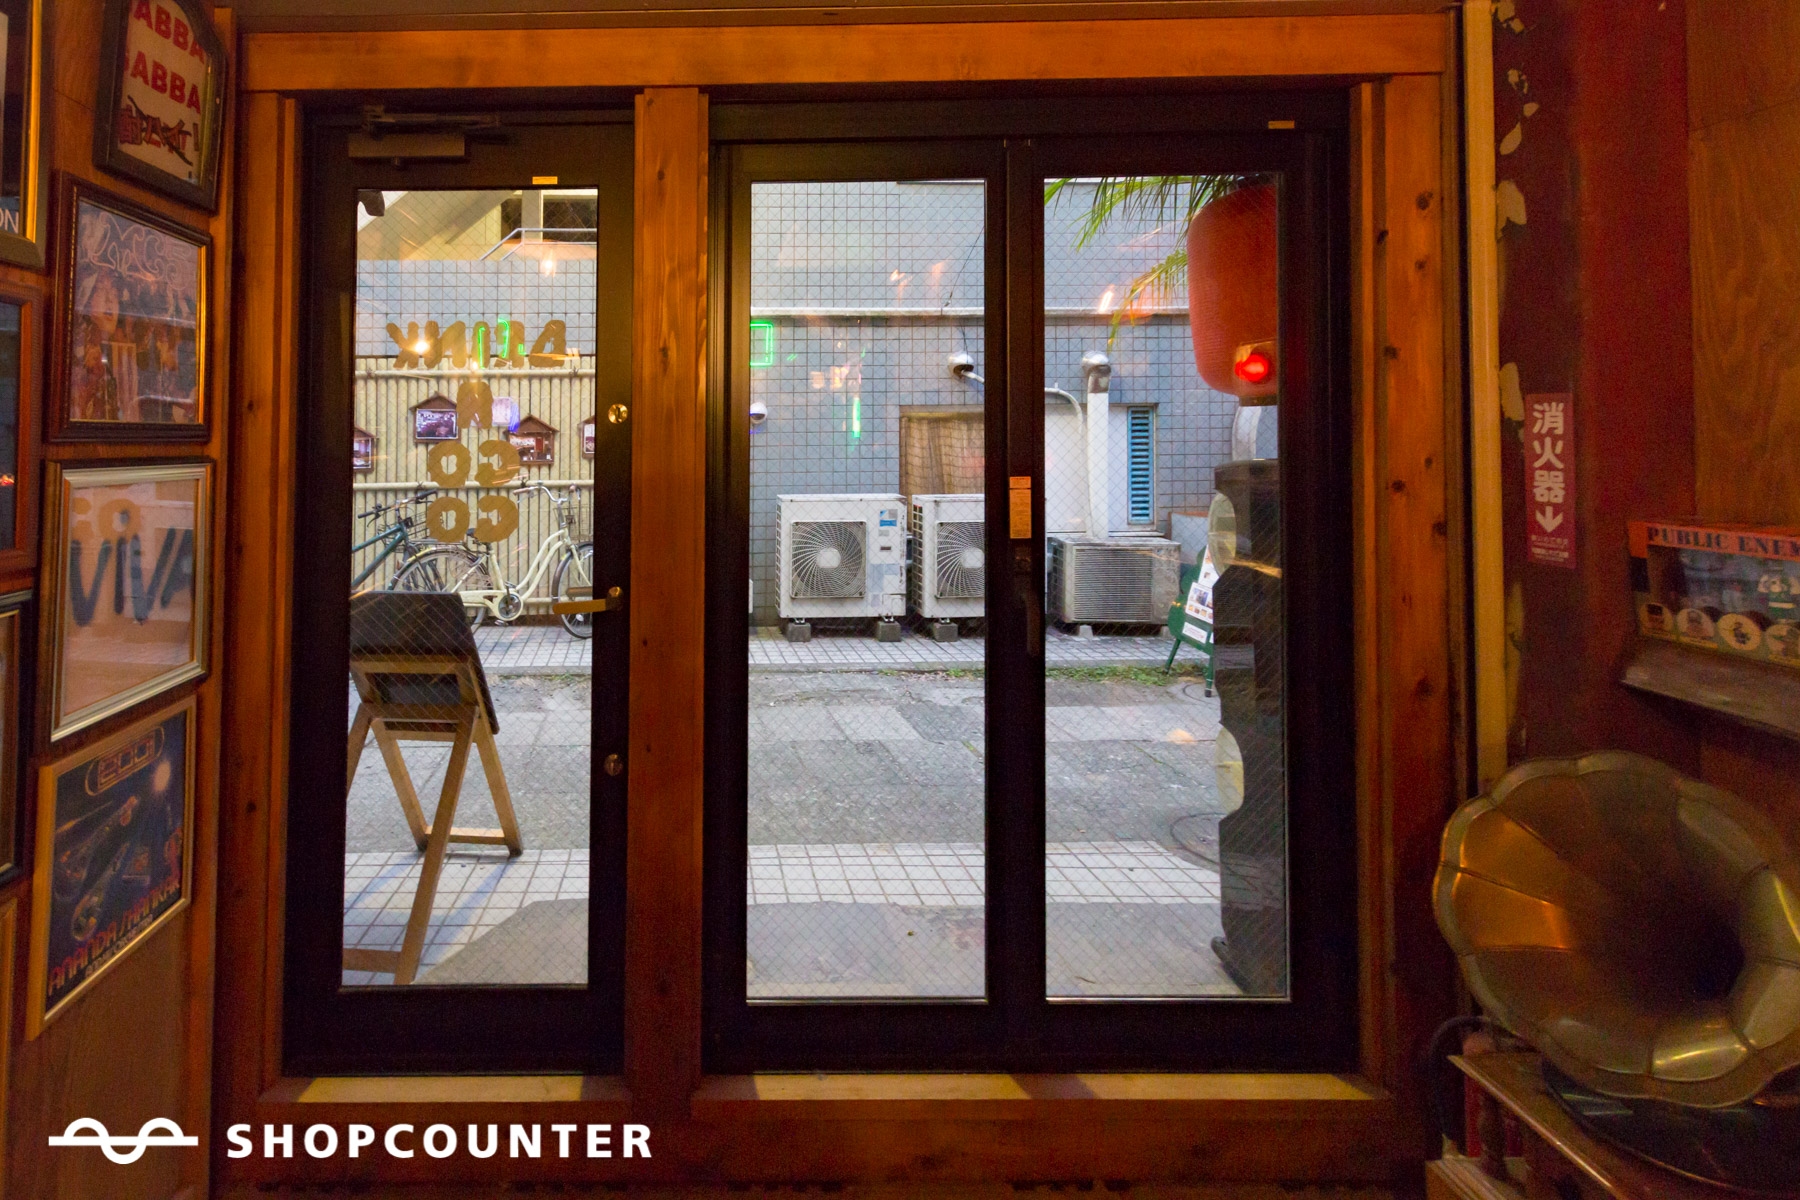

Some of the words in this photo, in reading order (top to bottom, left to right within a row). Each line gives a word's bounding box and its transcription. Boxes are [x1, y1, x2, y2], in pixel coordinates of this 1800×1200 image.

[123, 50, 201, 115] ABBA
[1532, 401, 1566, 504] 消火器
[1647, 526, 1730, 550] PUBLIC
